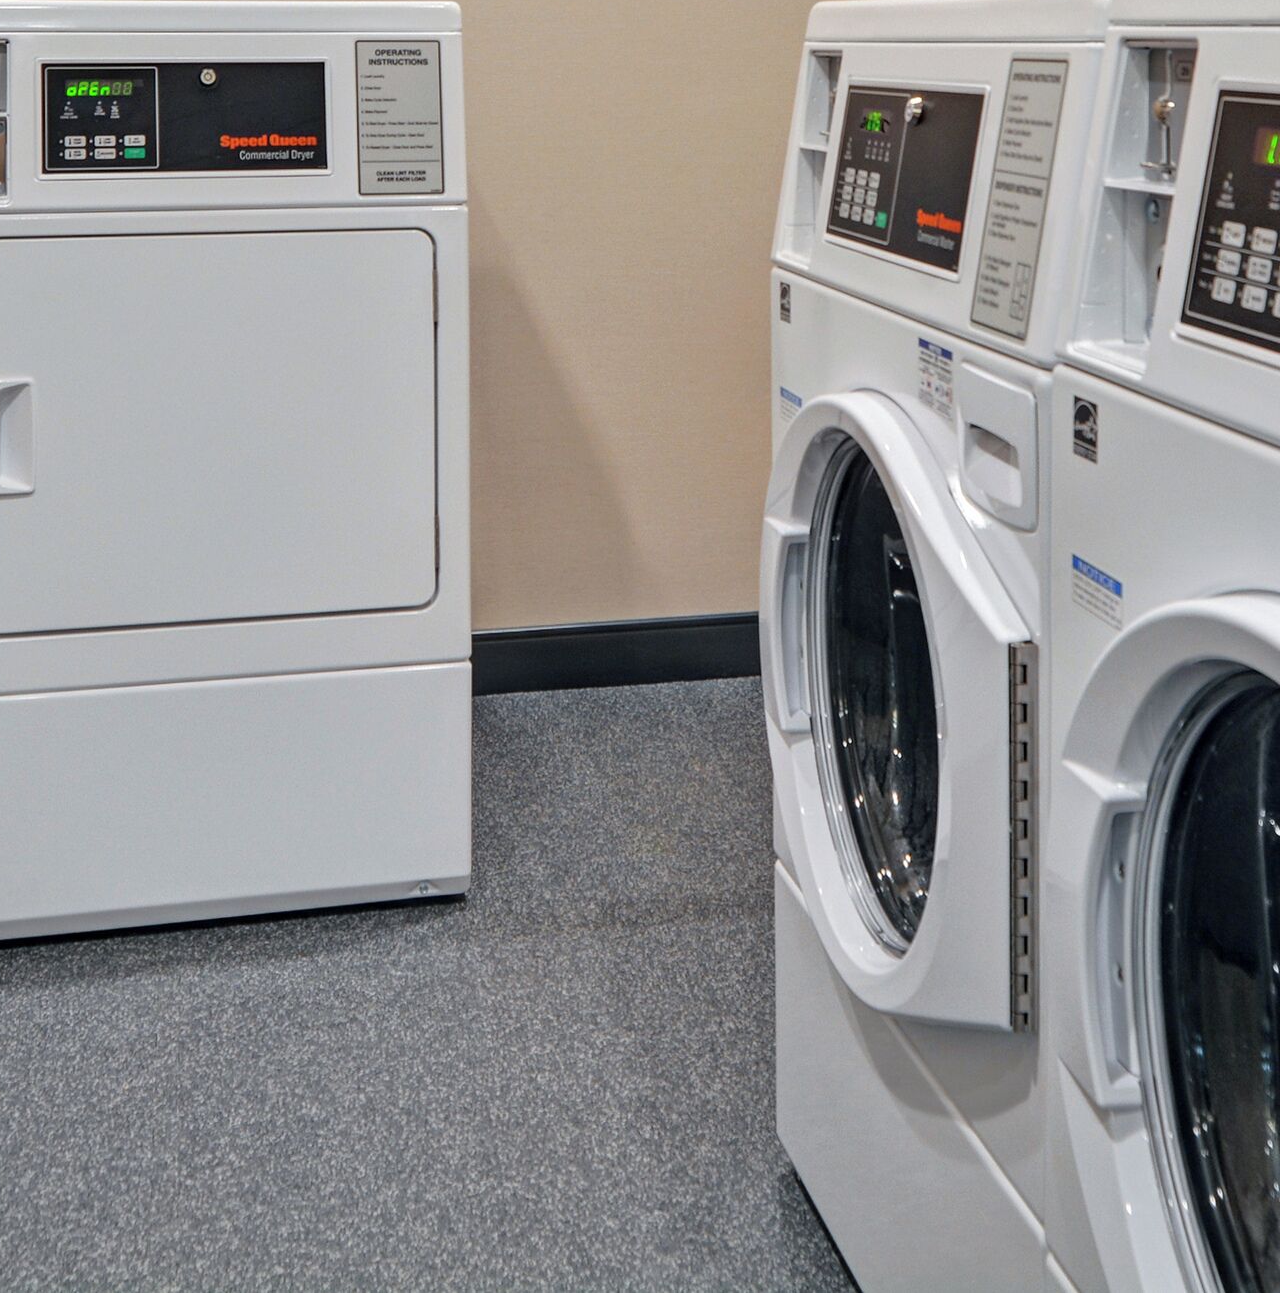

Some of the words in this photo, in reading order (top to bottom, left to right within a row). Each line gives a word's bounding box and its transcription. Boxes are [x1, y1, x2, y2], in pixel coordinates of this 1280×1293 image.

[368, 58, 429, 66] INSTRUCTIONS
[220, 134, 267, 149] Speed
[269, 133, 318, 146] Queen
[239, 150, 289, 160] Commercial
[291, 150, 315, 160] Dryer
